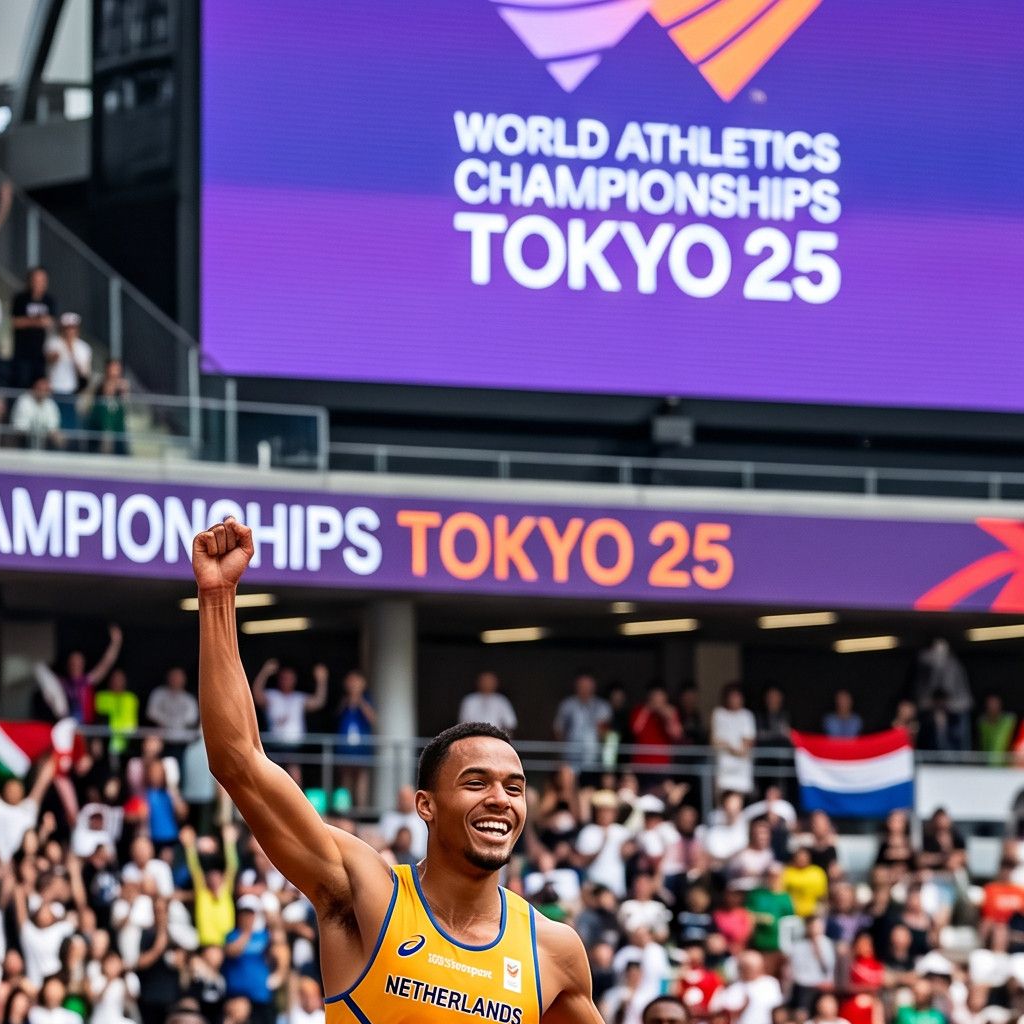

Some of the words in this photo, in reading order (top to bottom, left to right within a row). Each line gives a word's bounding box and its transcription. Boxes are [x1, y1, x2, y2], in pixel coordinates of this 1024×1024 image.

[454, 110, 610, 159] WORLD
[615, 122, 843, 174] ATHLETICS
[454, 158, 843, 225] CHAMPIONSHIPS
[454, 212, 733, 300] TOKYO
[743, 228, 843, 305] 25
[396, 509, 635, 588] TOKYO
[649, 521, 735, 591] 25
